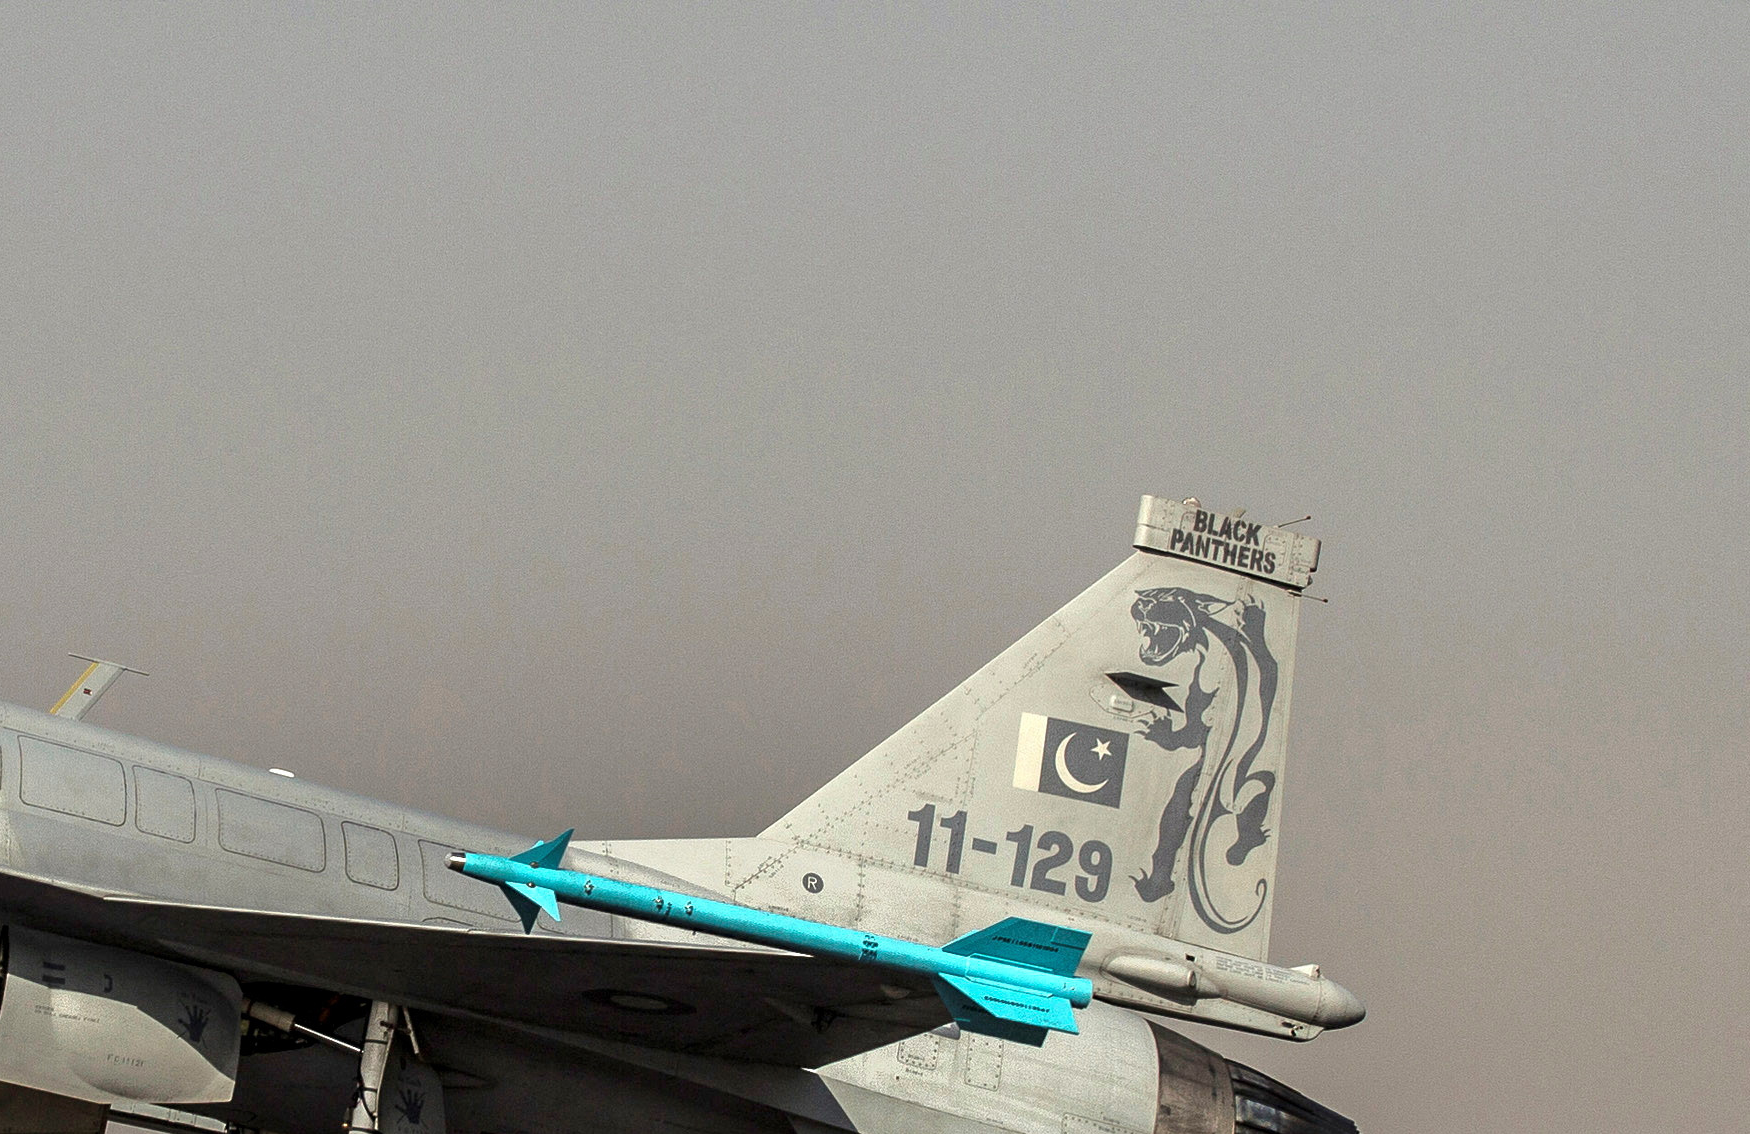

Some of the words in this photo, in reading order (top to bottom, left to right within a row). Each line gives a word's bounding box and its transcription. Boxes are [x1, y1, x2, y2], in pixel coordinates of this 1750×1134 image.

[1193, 509, 1262, 546] BLACK
[1170, 528, 1276, 574] PANTHERS
[907, 803, 1114, 903] 11-129
[806, 876, 819, 891] R
